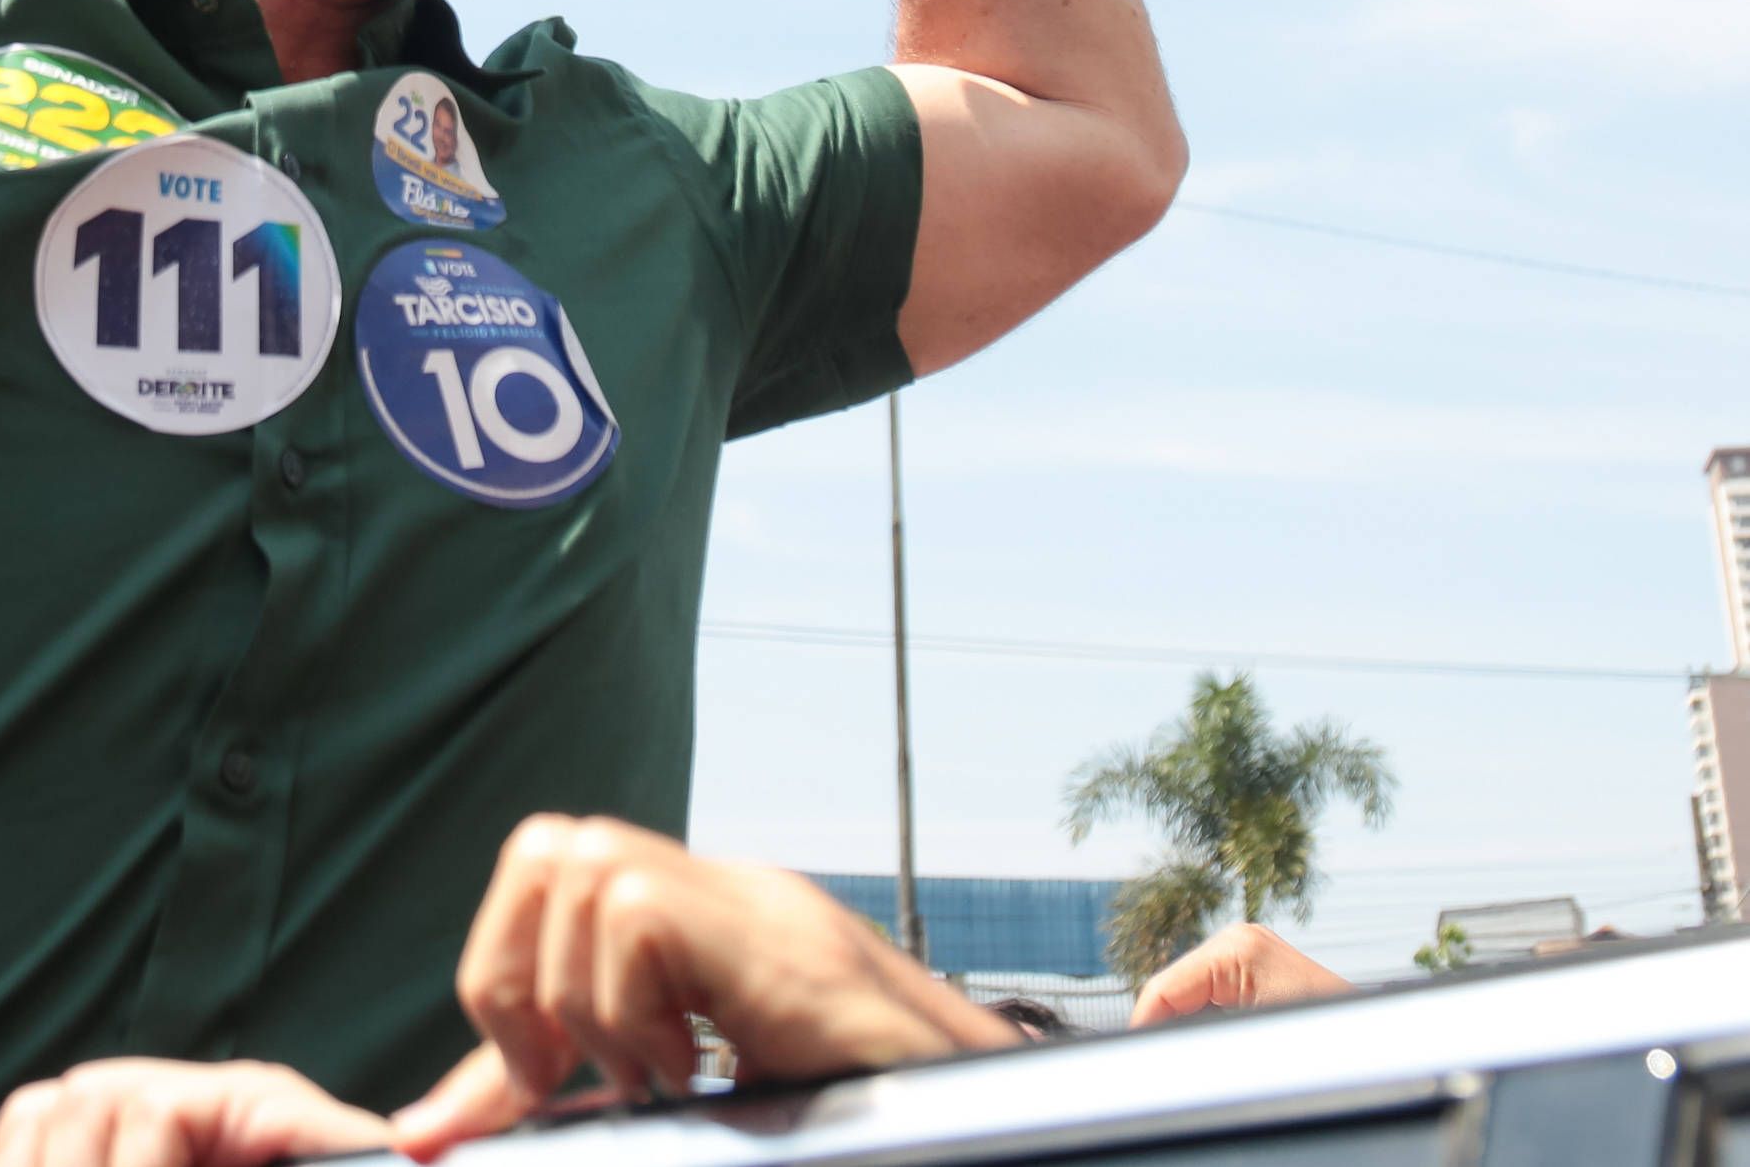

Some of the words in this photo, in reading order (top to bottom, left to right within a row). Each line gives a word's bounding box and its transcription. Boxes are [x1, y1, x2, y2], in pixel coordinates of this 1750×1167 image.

[394, 95, 428, 154] 22
[158, 171, 222, 203] VOTE
[73, 207, 301, 360] 111
[437, 260, 478, 278] VOTE
[422, 345, 584, 470] 10
